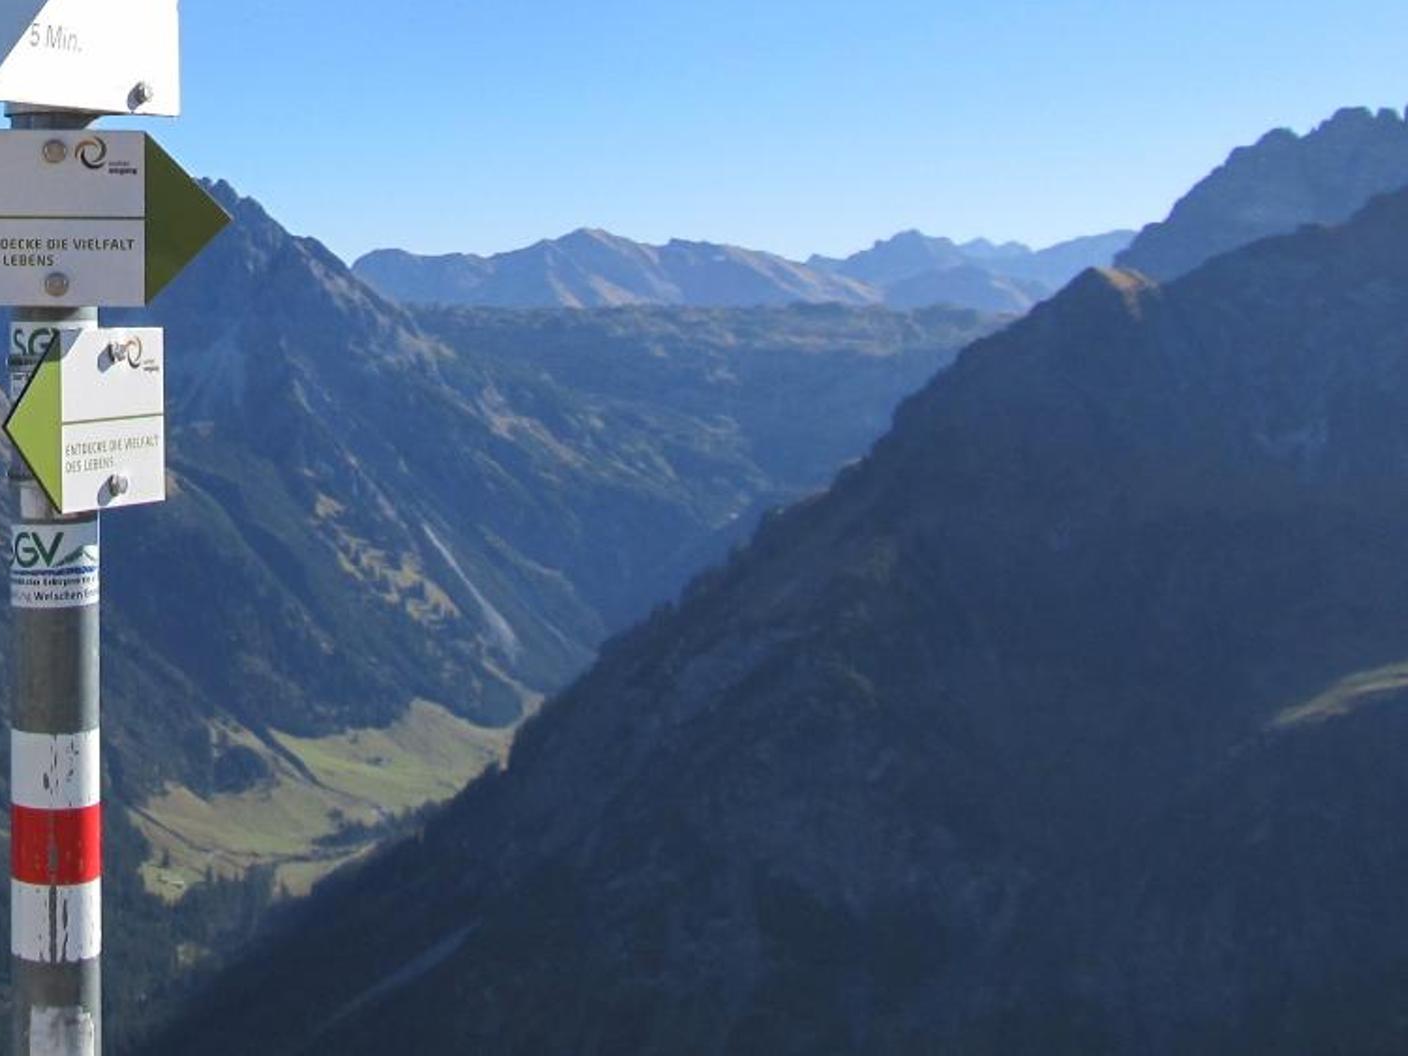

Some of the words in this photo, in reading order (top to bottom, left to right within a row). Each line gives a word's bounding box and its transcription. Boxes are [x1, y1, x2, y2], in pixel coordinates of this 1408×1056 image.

[30, 23, 40, 47] 5
[46, 25, 83, 52] Min.
[46, 239, 68, 251] DIE
[72, 239, 135, 251] VIELFALT
[2, 254, 55, 267] LEBENS
